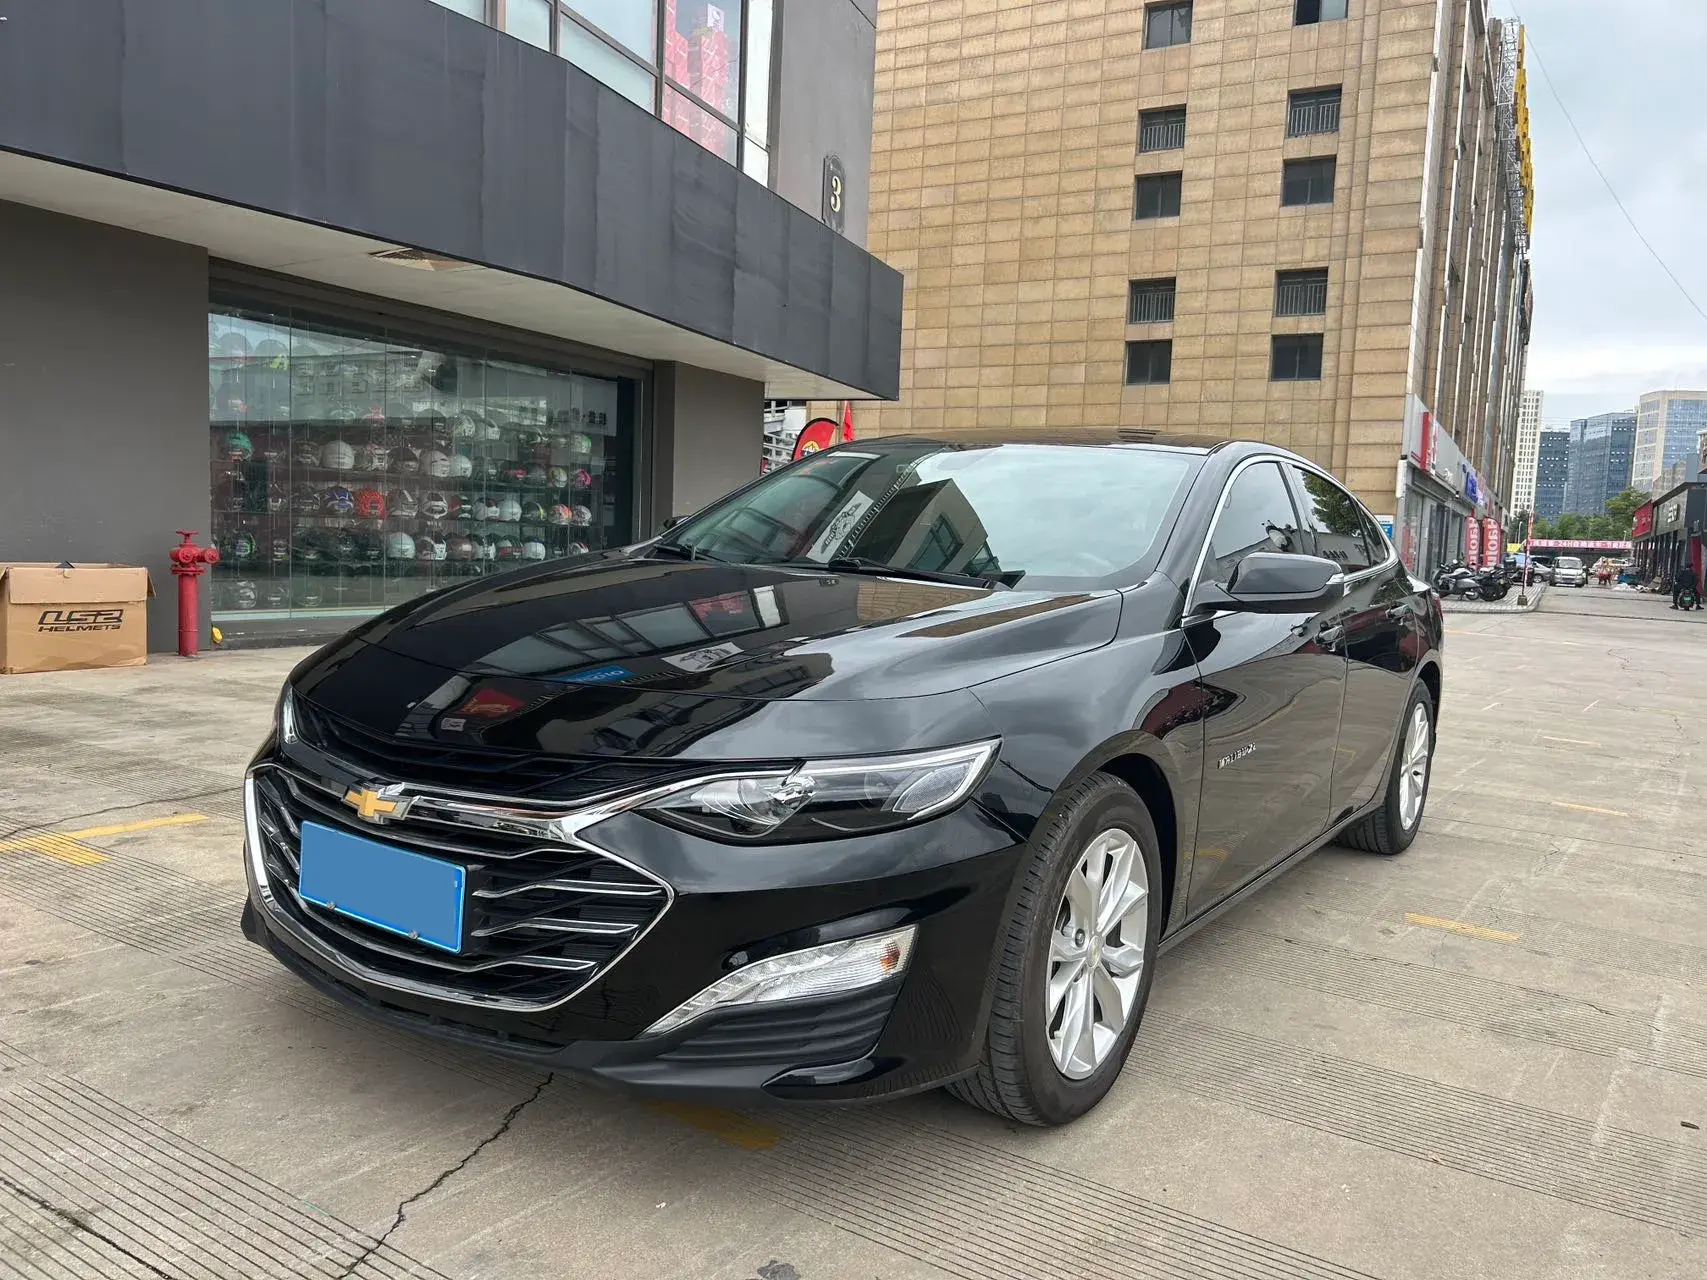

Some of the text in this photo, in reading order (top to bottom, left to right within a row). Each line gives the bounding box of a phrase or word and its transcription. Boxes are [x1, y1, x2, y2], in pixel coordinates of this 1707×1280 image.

[830, 175, 842, 213] 3
[37, 609, 124, 625] LS2
[37, 623, 121, 633] HELMETS
